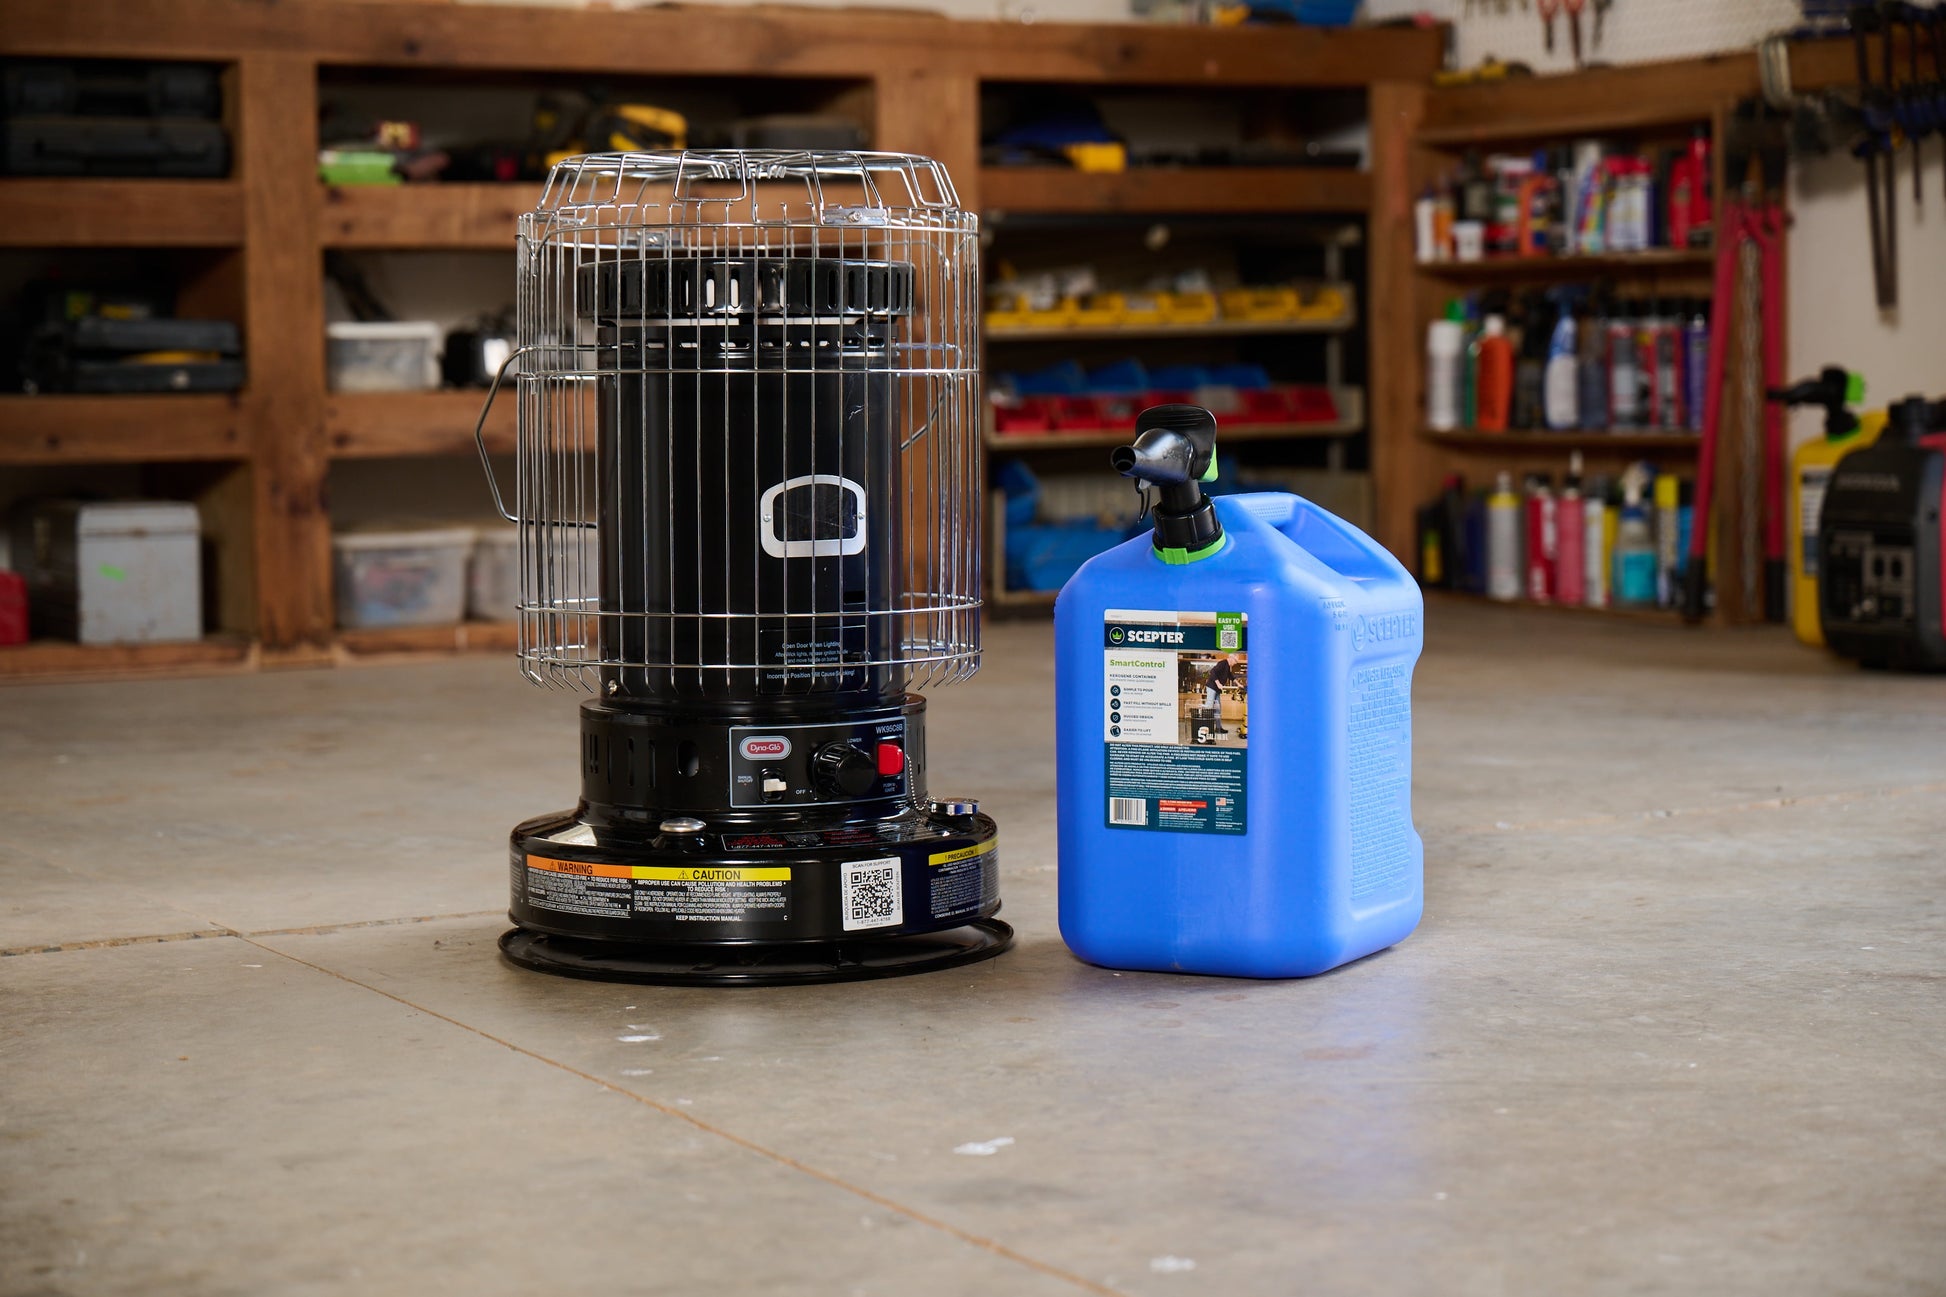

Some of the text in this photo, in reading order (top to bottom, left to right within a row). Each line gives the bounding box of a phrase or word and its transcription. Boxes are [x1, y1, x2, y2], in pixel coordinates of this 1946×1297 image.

[1127, 630, 1184, 644] SCEPTER
[1368, 614, 1416, 643] SCEPTER
[1109, 659, 1166, 669] SmartControl
[1197, 726, 1210, 743] 5
[557, 861, 741, 881] WARNING CAUTION
